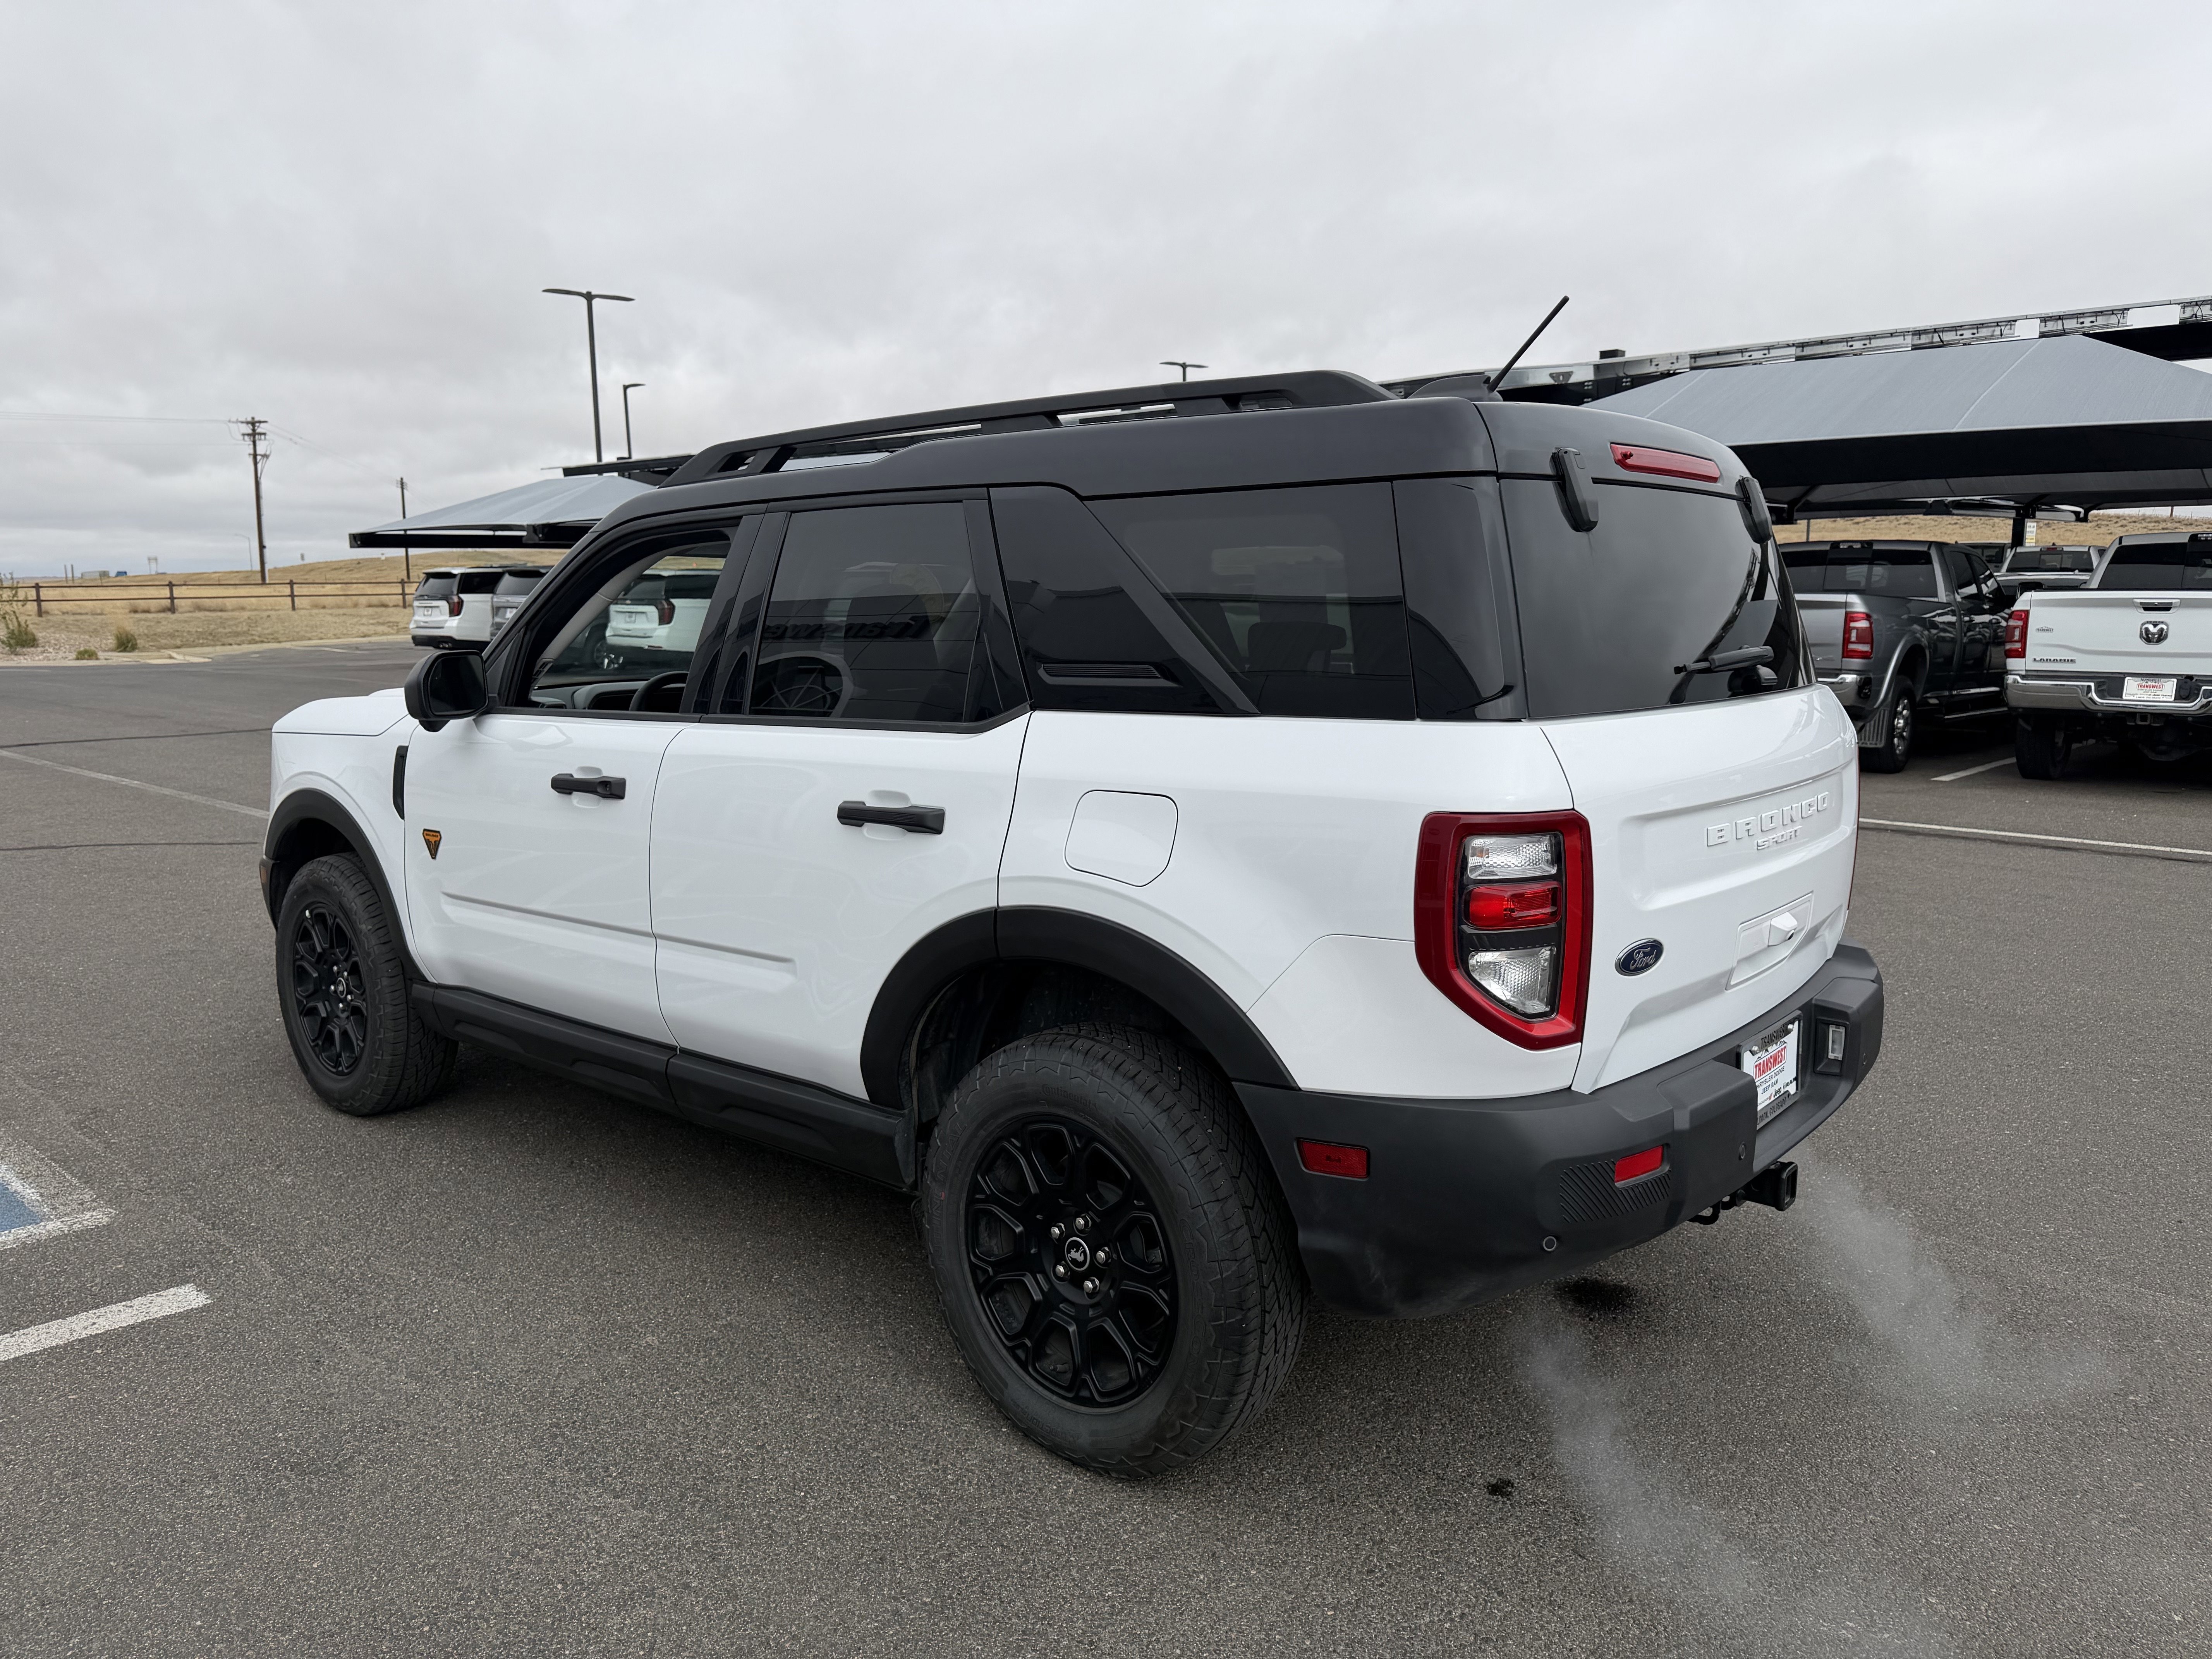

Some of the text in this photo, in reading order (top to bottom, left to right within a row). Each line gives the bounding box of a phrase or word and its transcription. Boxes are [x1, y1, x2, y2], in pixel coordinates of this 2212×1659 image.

[1706, 792, 1829, 847] BRONCO
[1756, 826, 1802, 850] SPORT
[1630, 947, 1657, 970] Ford
[1755, 1045, 1786, 1080] TRANSWEST
[1757, 1074, 1773, 1088] HRYSLER
